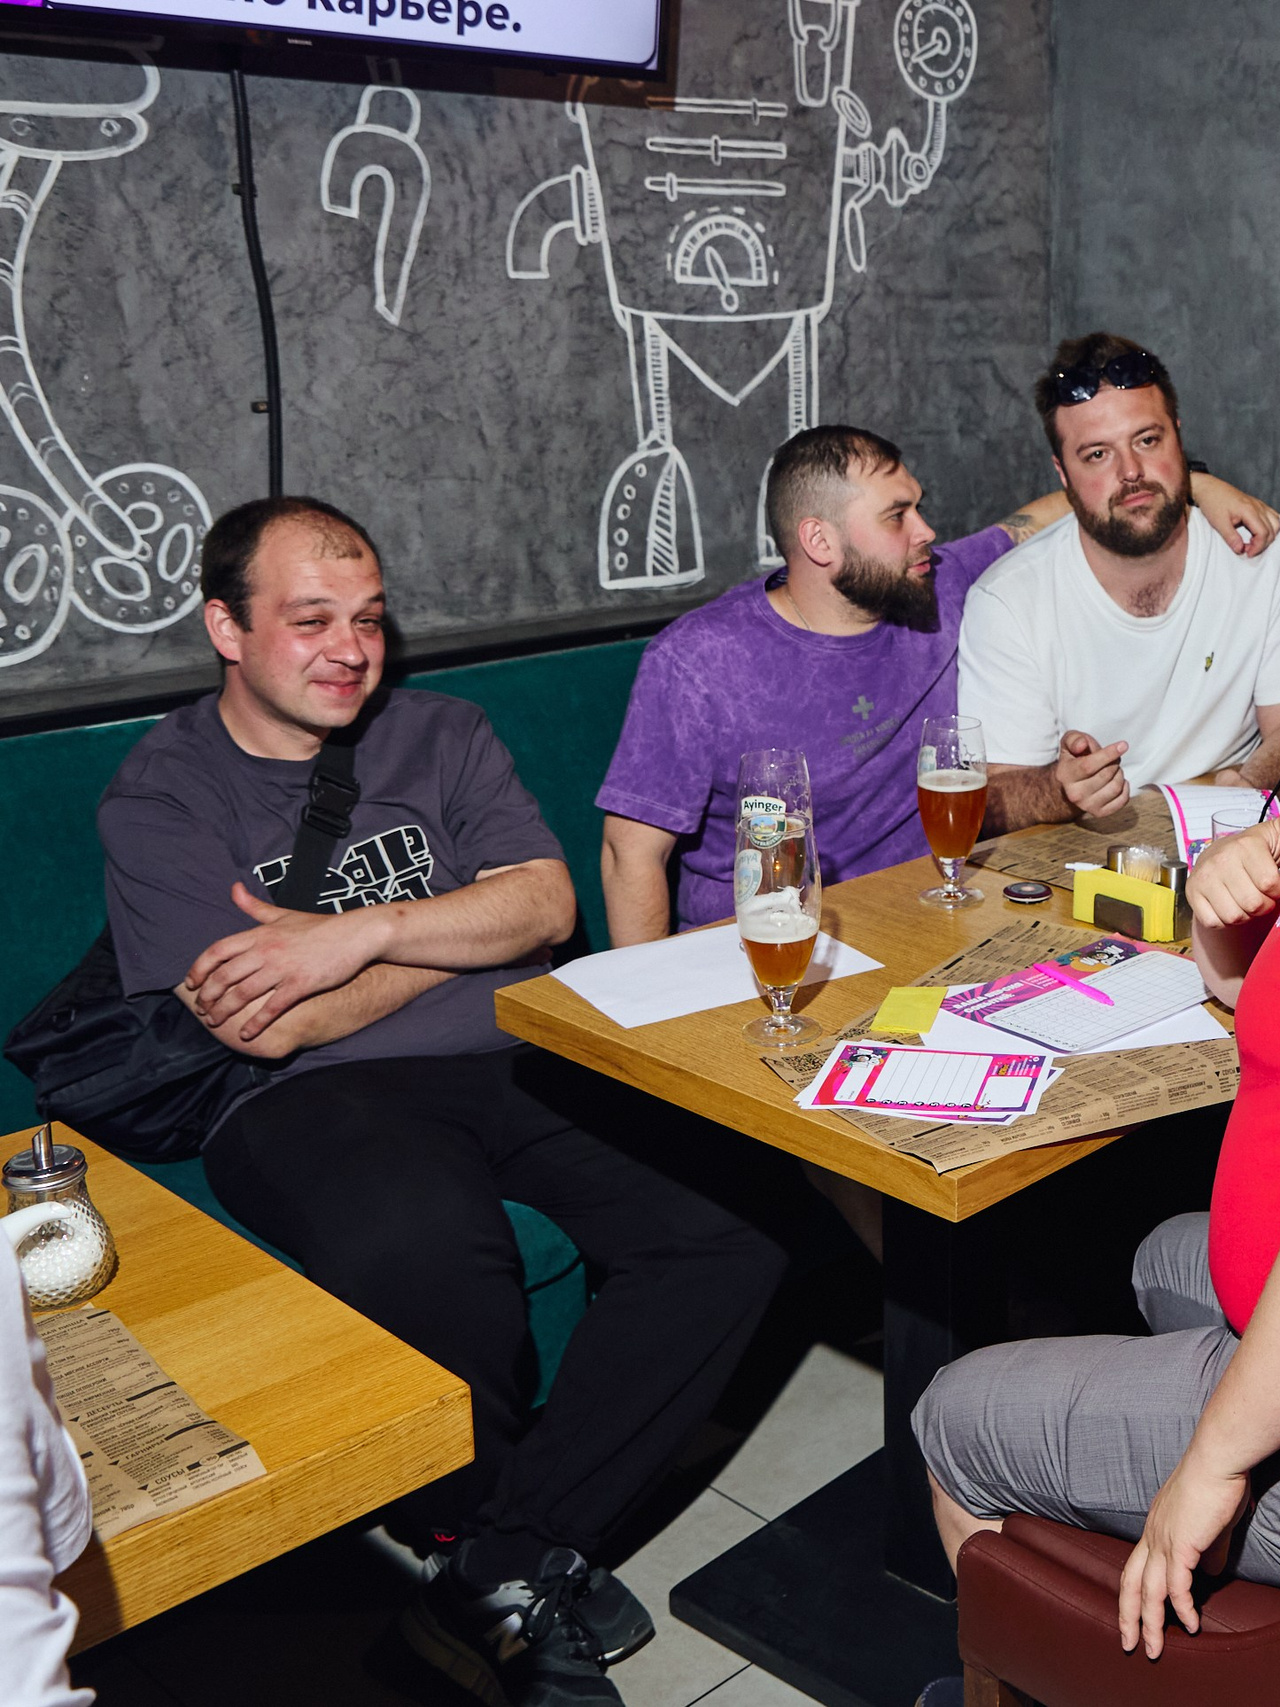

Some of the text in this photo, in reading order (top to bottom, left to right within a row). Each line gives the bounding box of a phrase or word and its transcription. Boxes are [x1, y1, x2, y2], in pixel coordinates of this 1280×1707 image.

[743, 799, 783, 812] Ayinger
[86, 1400, 124, 1417] ДЕСЕРТЫ
[125, 1439, 165, 1460] ГАРНИРЫ
[154, 1468, 186, 1485] СОУСЫ
